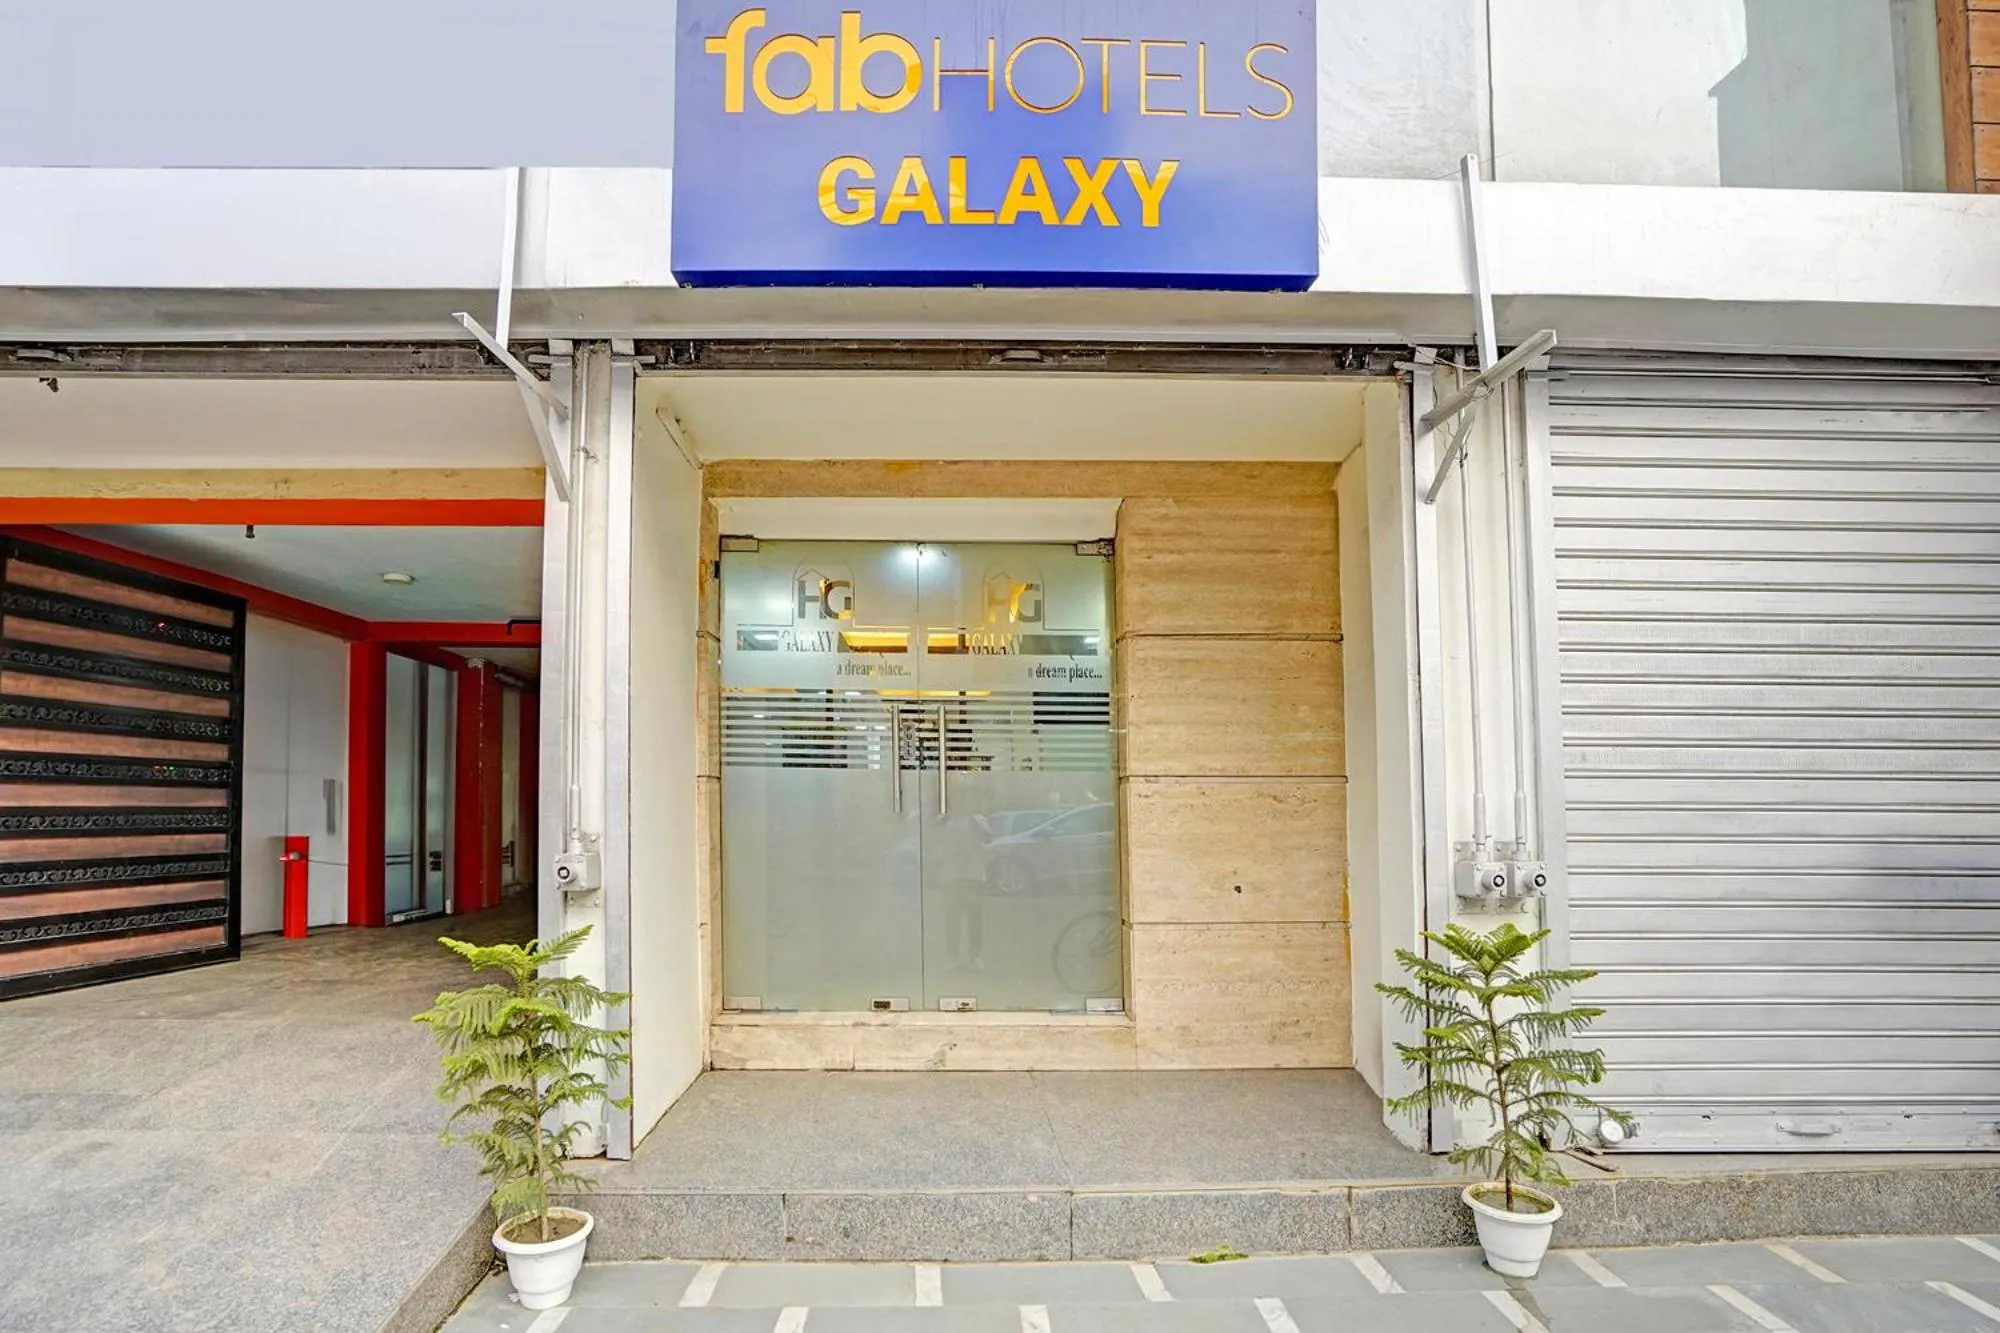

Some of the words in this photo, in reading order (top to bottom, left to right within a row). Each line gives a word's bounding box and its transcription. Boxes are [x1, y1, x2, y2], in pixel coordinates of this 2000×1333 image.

[818, 156, 1180, 227] GALAXY
[798, 579, 851, 620] HG
[1035, 663, 1067, 678] dream
